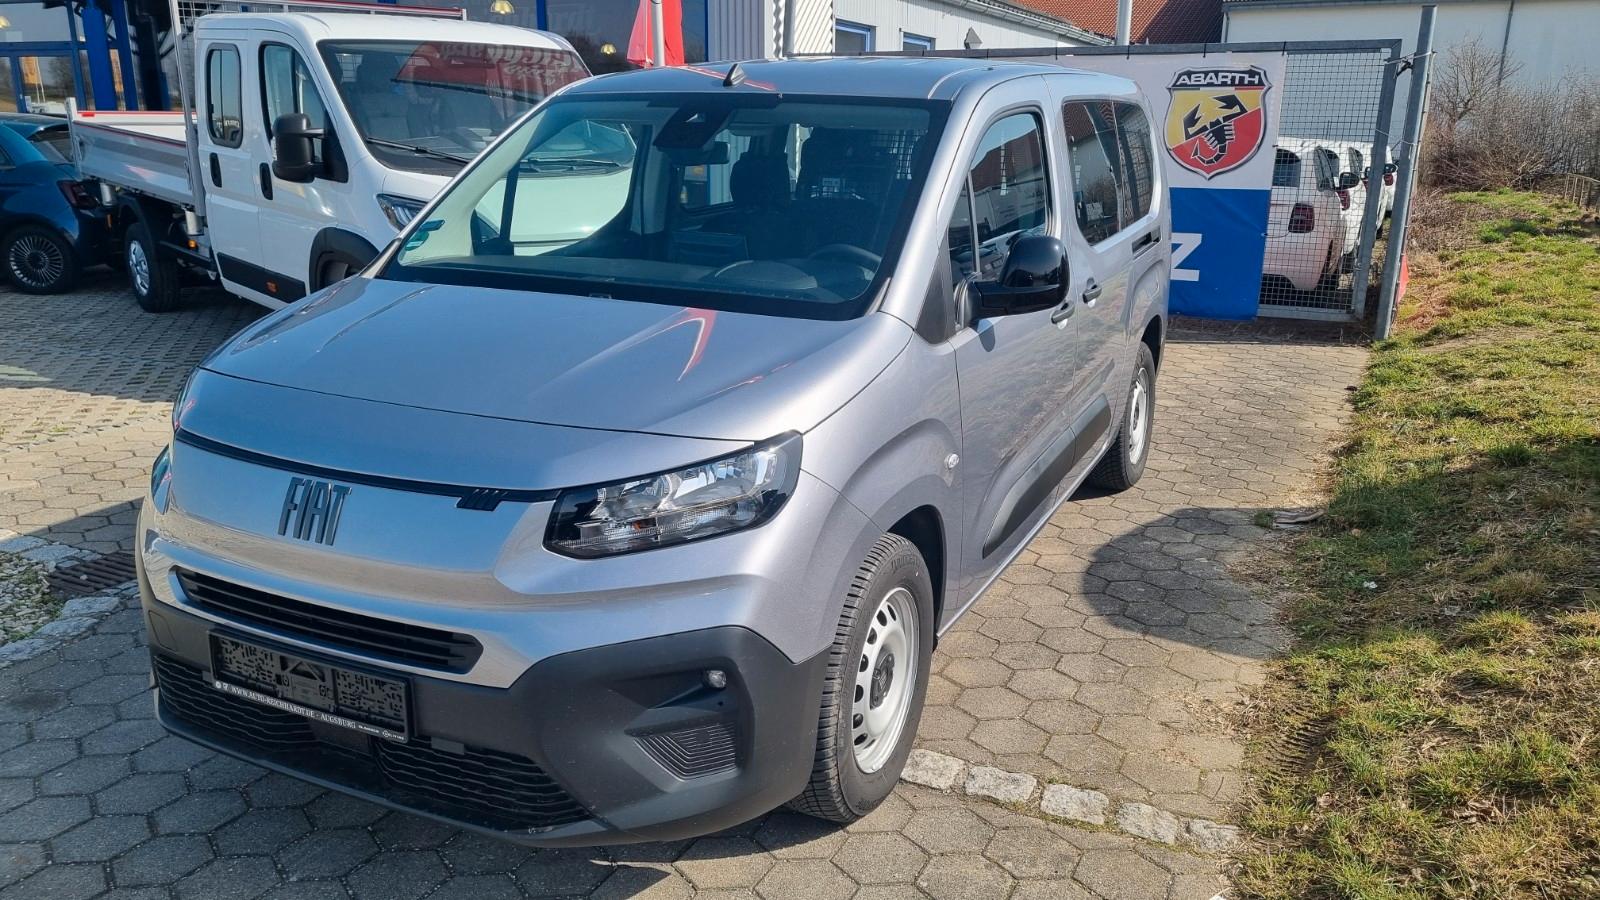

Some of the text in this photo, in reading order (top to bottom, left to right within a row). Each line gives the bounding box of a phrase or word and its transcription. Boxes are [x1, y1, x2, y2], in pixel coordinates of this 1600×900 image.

[1175, 72, 1260, 85] ABARTH
[278, 477, 352, 546] FIAT
[320, 713, 356, 729] AUGSBURG
